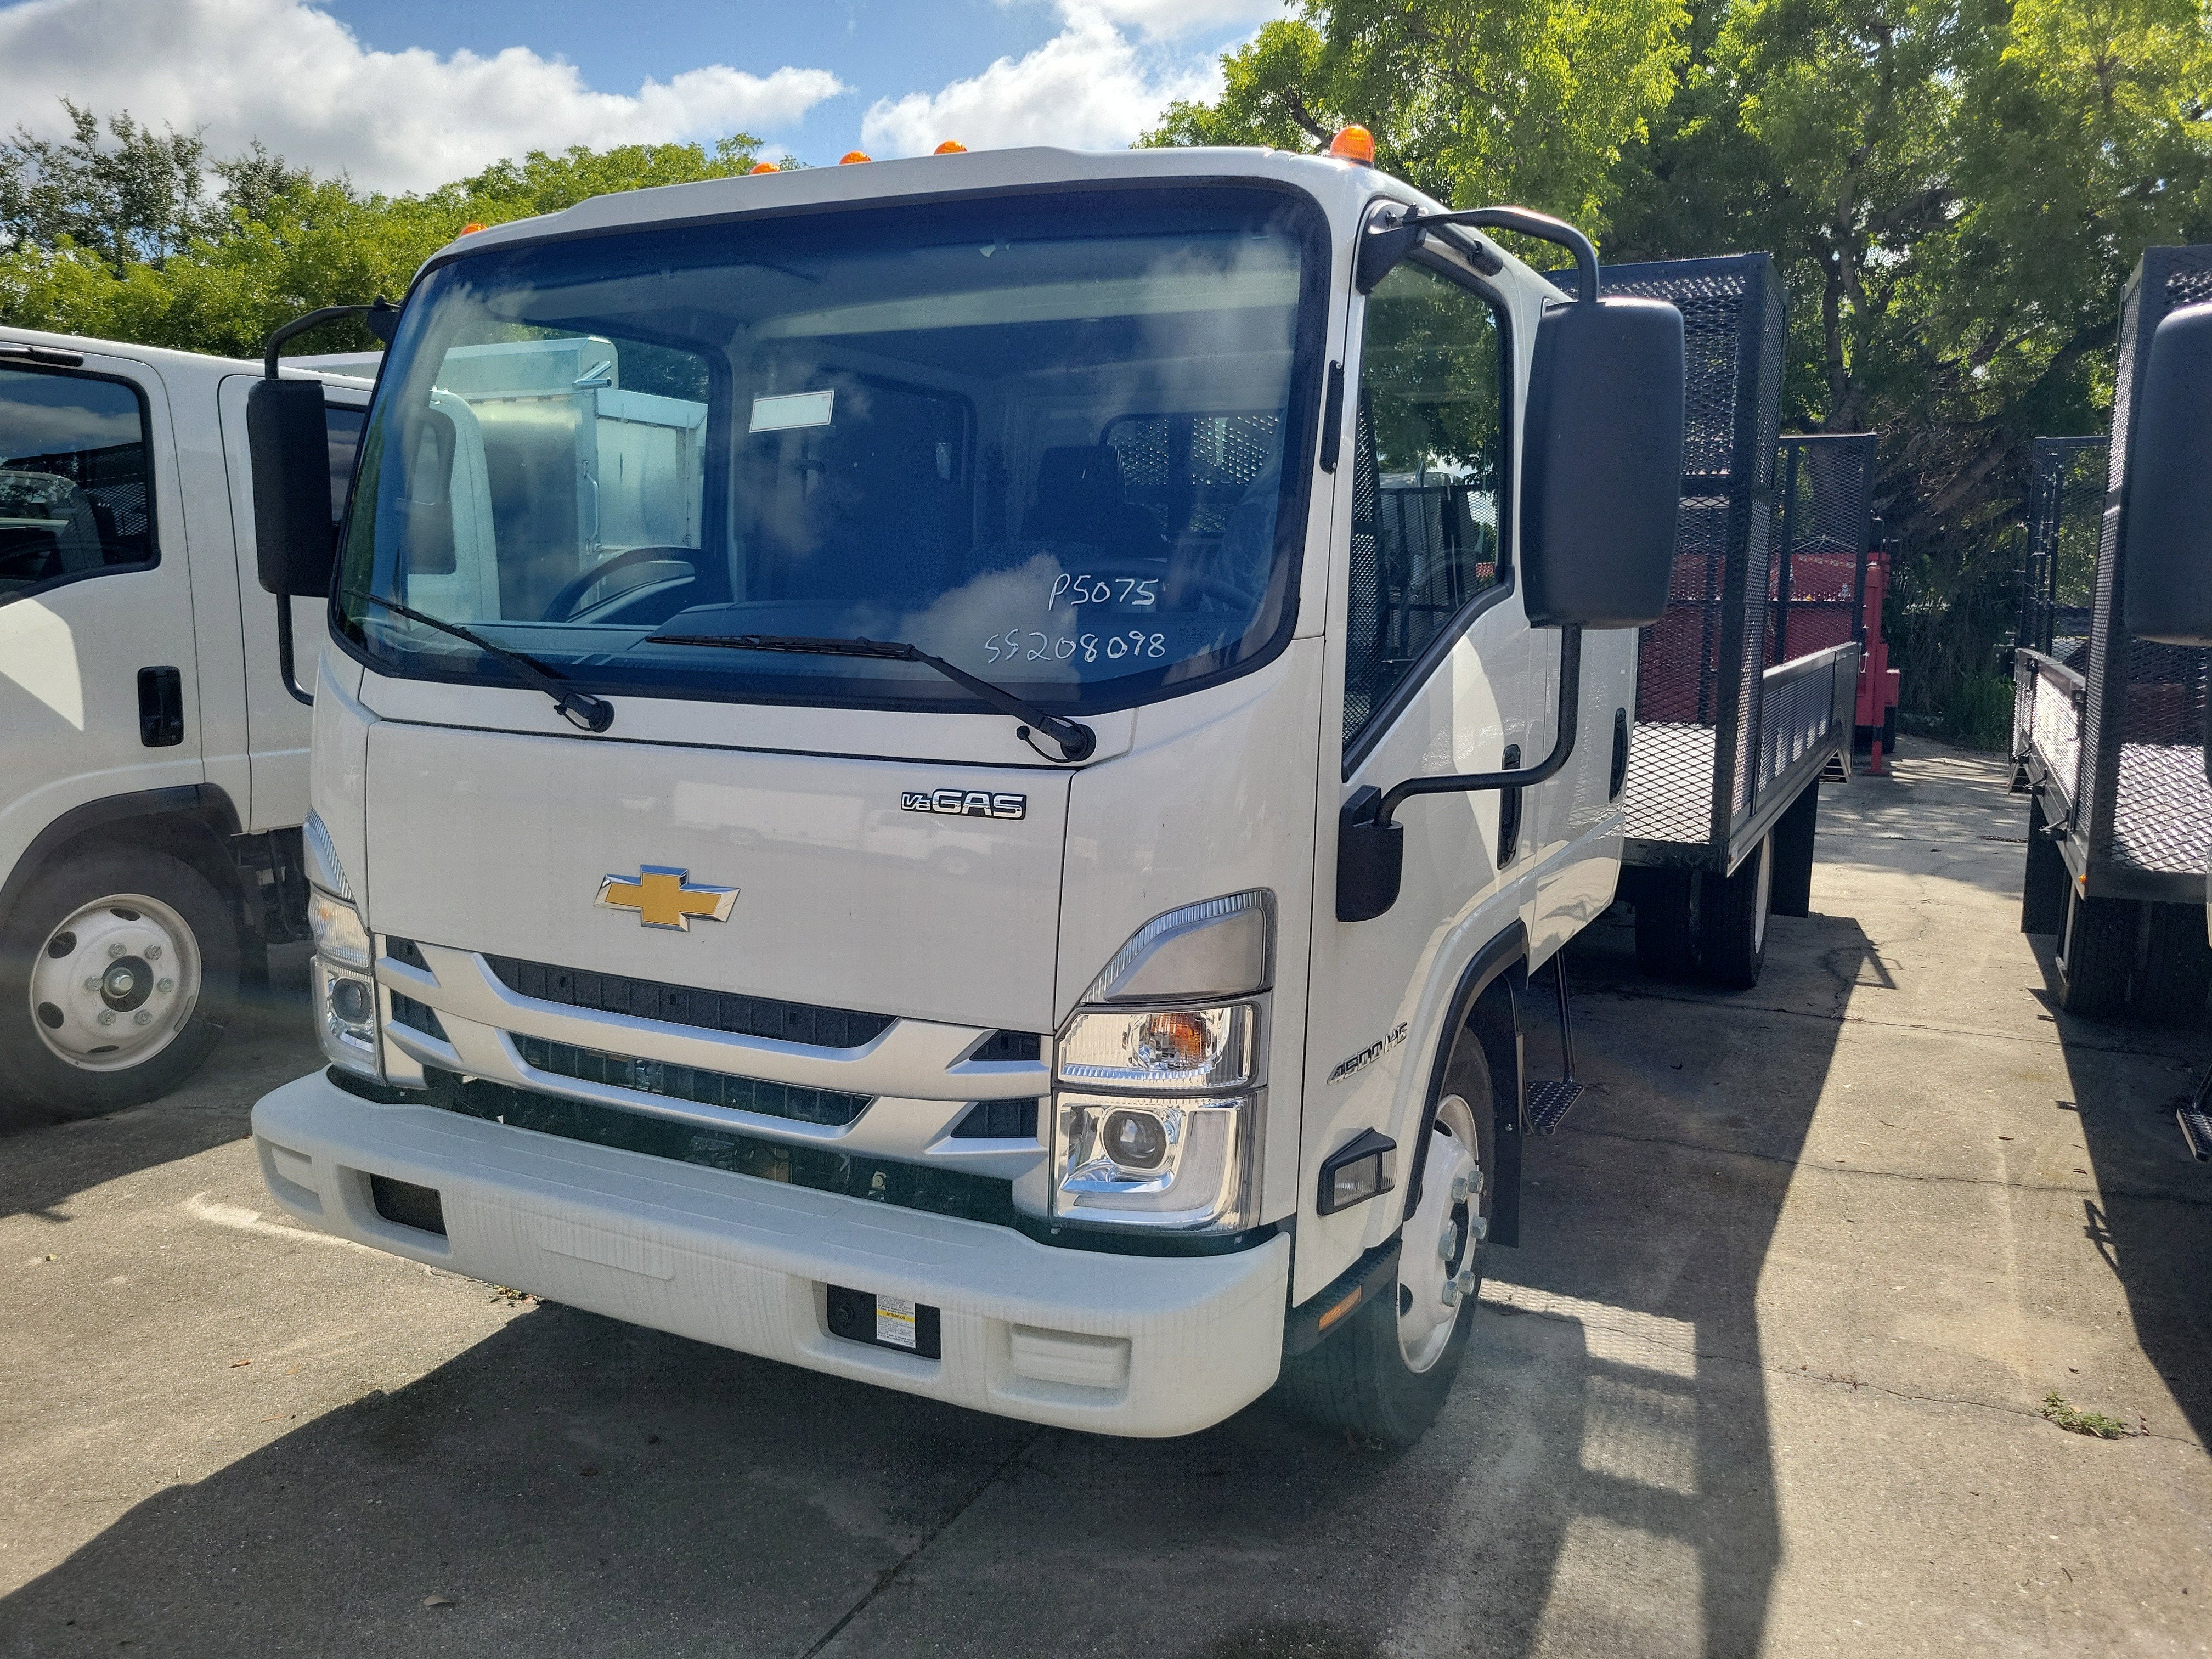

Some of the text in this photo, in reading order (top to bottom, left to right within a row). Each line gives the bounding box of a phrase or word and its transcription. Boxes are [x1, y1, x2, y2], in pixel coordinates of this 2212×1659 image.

[1048, 573, 1159, 611] P5075
[932, 789, 1024, 819] GAS
[1327, 1040, 1383, 1085] 4500
